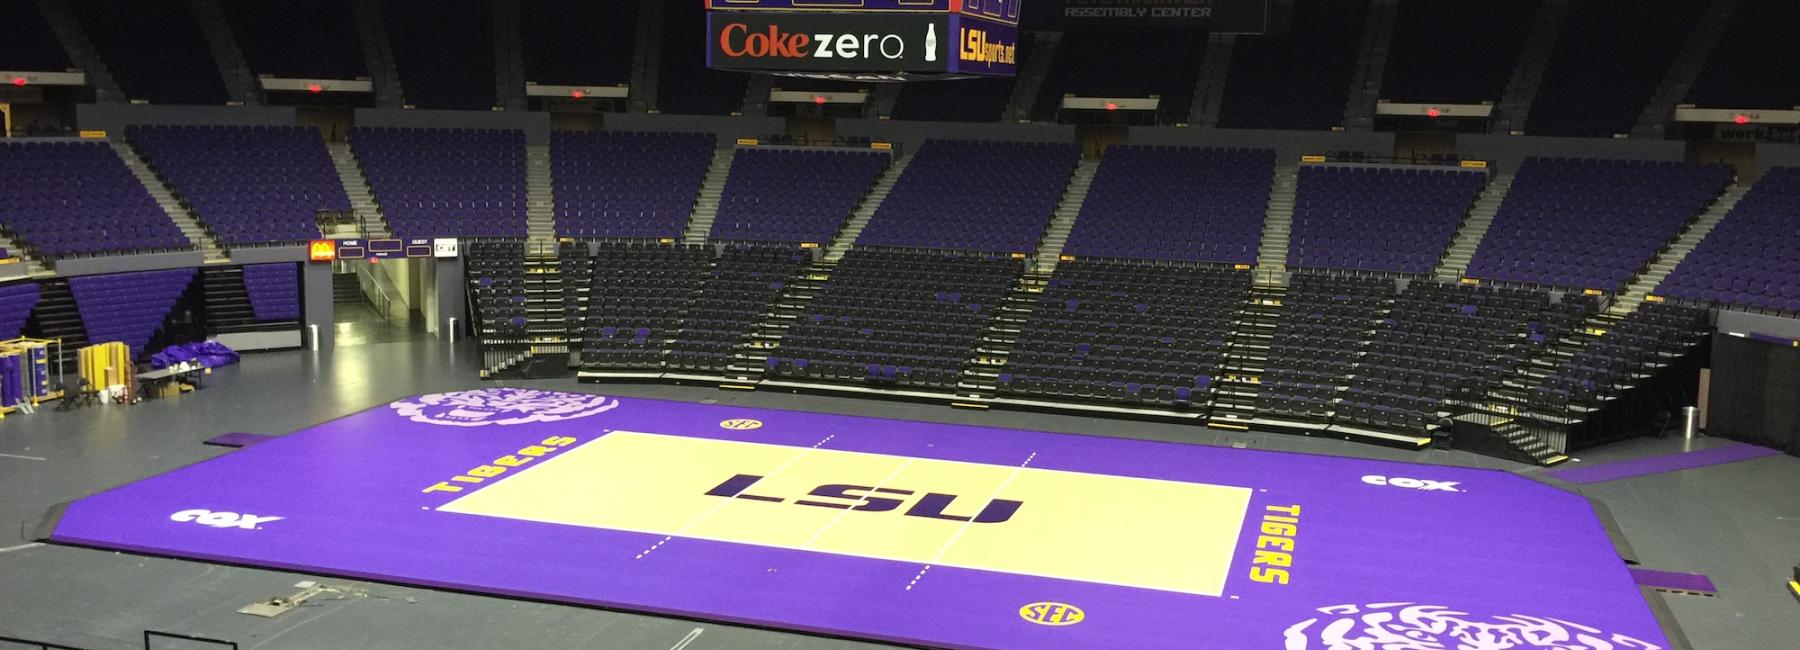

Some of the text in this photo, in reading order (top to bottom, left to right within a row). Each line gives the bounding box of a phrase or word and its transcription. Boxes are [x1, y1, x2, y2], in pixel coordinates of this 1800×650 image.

[1065, 7, 1212, 18] ASSEMBLY CENTER
[719, 23, 905, 59] Coke zero
[422, 436, 577, 494] TIGERS
[1361, 475, 1462, 492] COX
[704, 474, 1024, 524] LSU
[170, 509, 286, 529] COX
[1249, 504, 1301, 585] TIGERS
[1023, 603, 1081, 623] SEC
